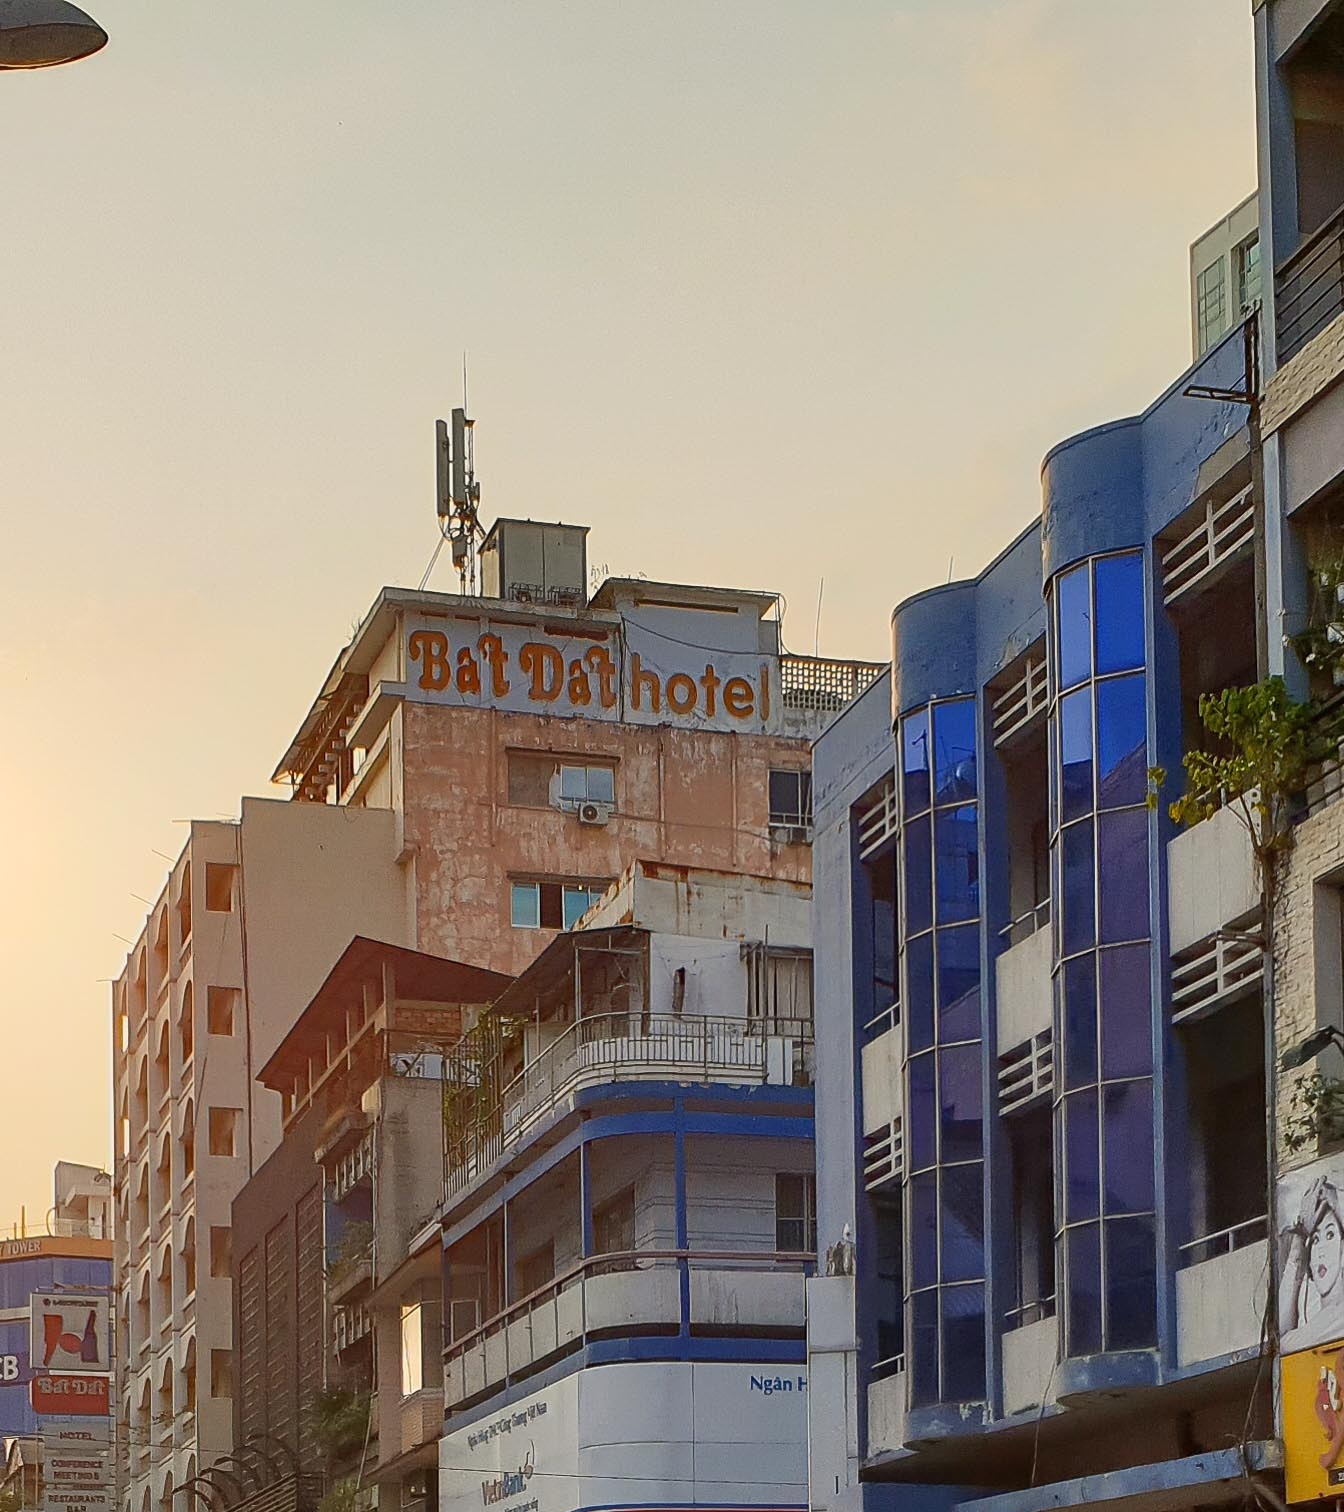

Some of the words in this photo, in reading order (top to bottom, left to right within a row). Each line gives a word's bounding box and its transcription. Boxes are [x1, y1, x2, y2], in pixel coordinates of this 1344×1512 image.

[630, 652, 769, 721] hotel
[6, 1240, 42, 1256] TOWER
[750, 1375, 793, 1396] Ngân
